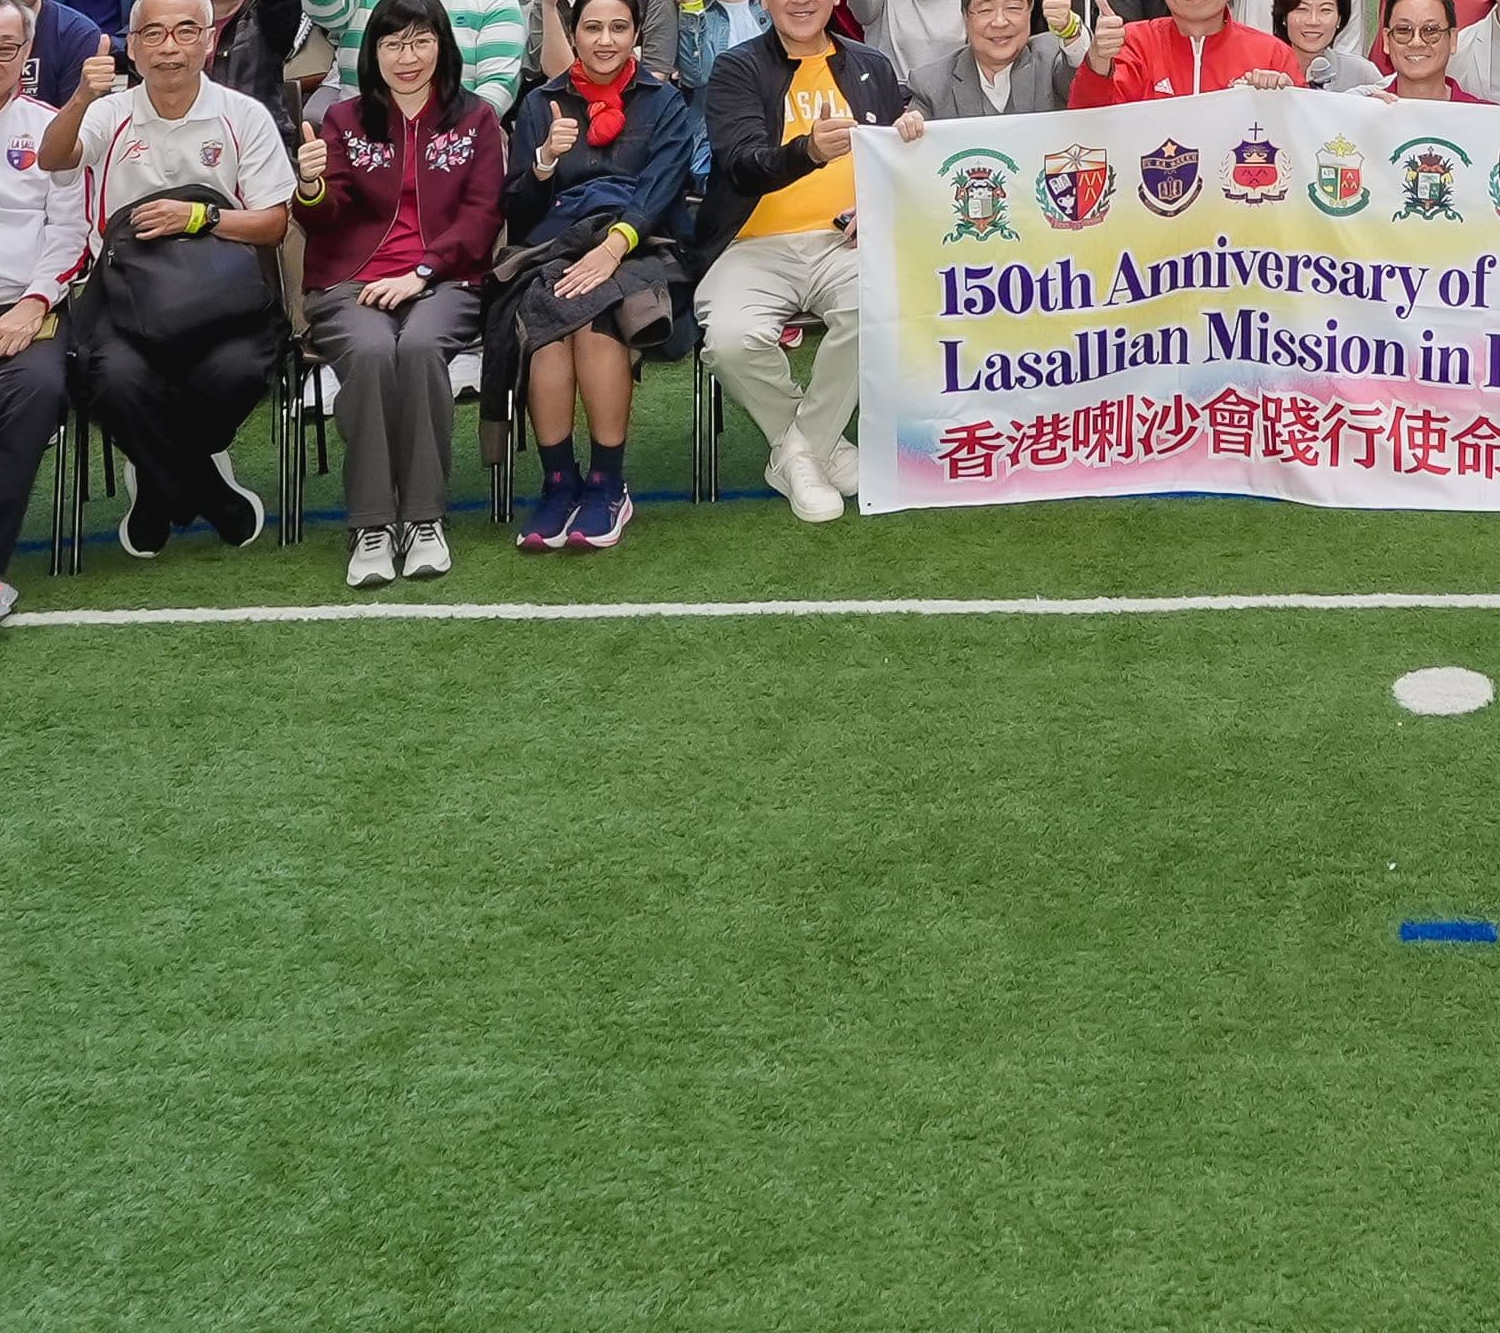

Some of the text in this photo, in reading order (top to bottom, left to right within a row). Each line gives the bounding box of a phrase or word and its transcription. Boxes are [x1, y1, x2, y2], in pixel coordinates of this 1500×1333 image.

[796, 89, 853, 121] SAL
[938, 258, 1094, 317] 150th
[1103, 235, 1430, 321] Anniversary
[1438, 254, 1498, 309] of
[938, 326, 1191, 395] Lasallian
[1202, 309, 1407, 379] Mission
[1420, 329, 1472, 387] in
